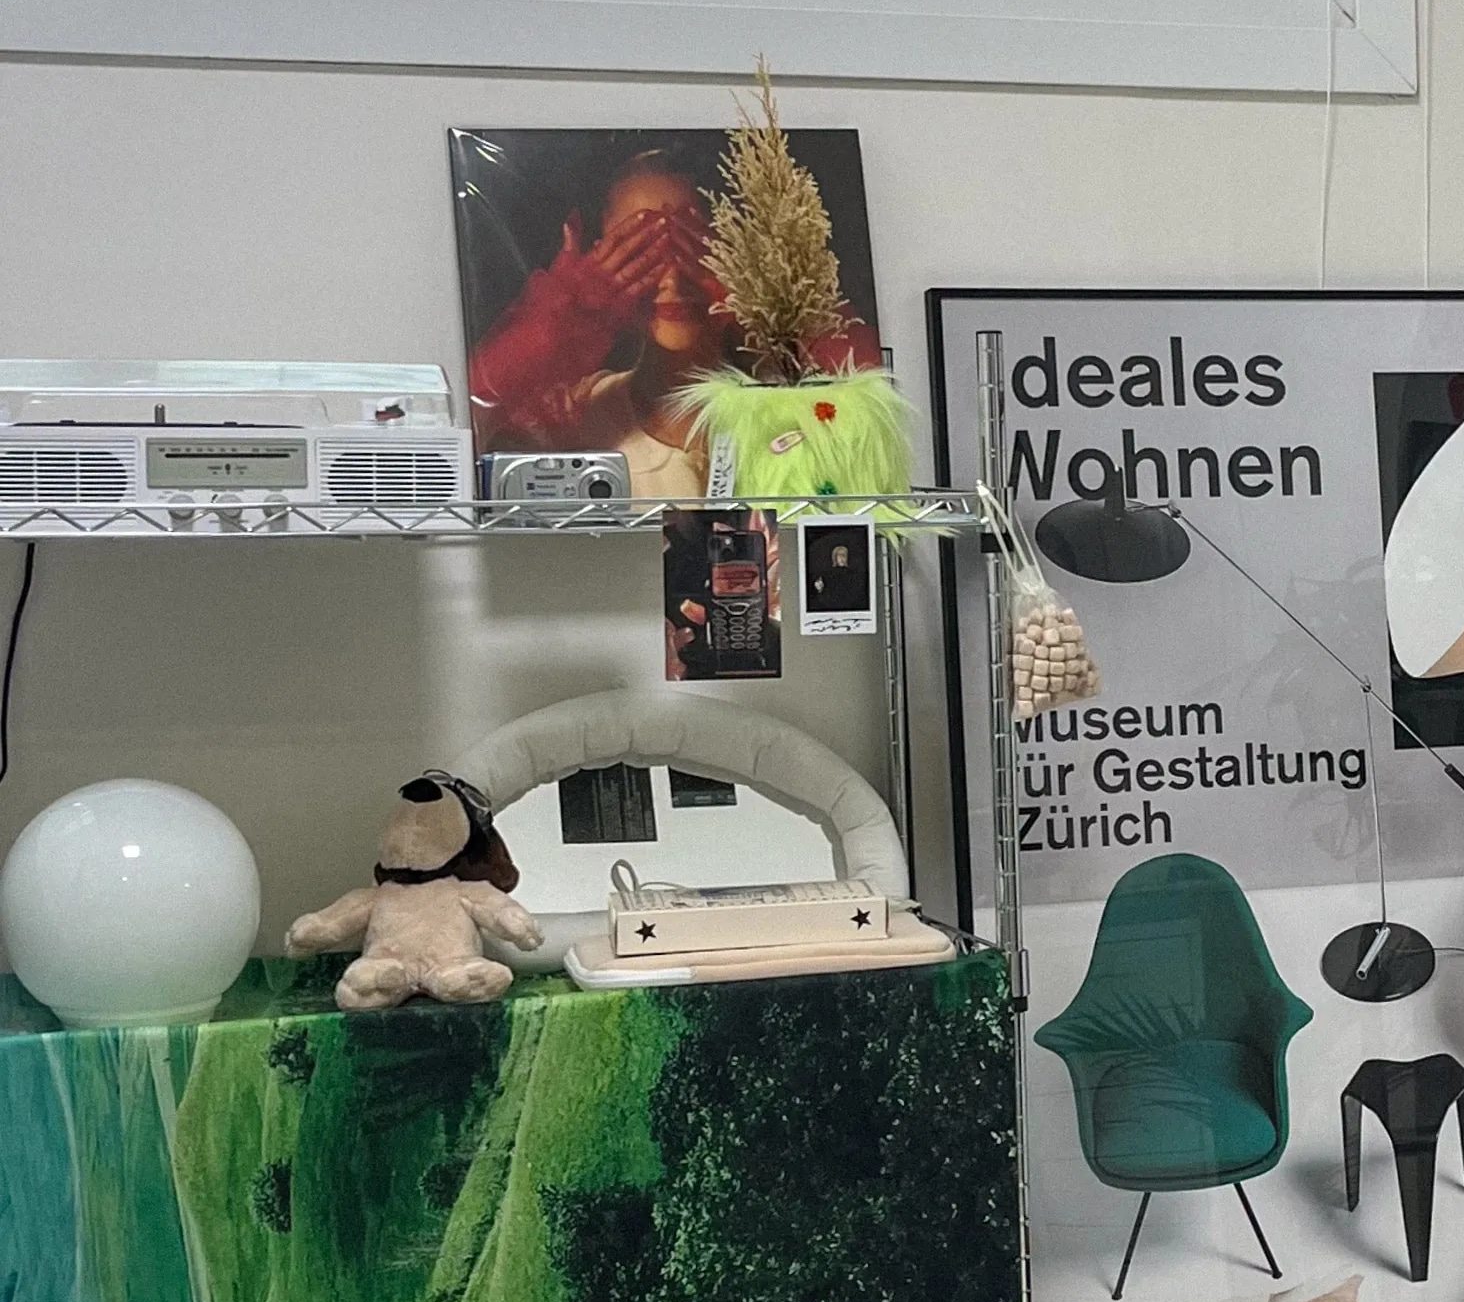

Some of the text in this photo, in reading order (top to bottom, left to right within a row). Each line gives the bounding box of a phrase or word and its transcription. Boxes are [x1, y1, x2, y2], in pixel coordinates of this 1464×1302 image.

[1010, 336, 1287, 409] deales
[1016, 742, 1367, 799] ür Gestaltung
[1018, 800, 1173, 852] Zürich
